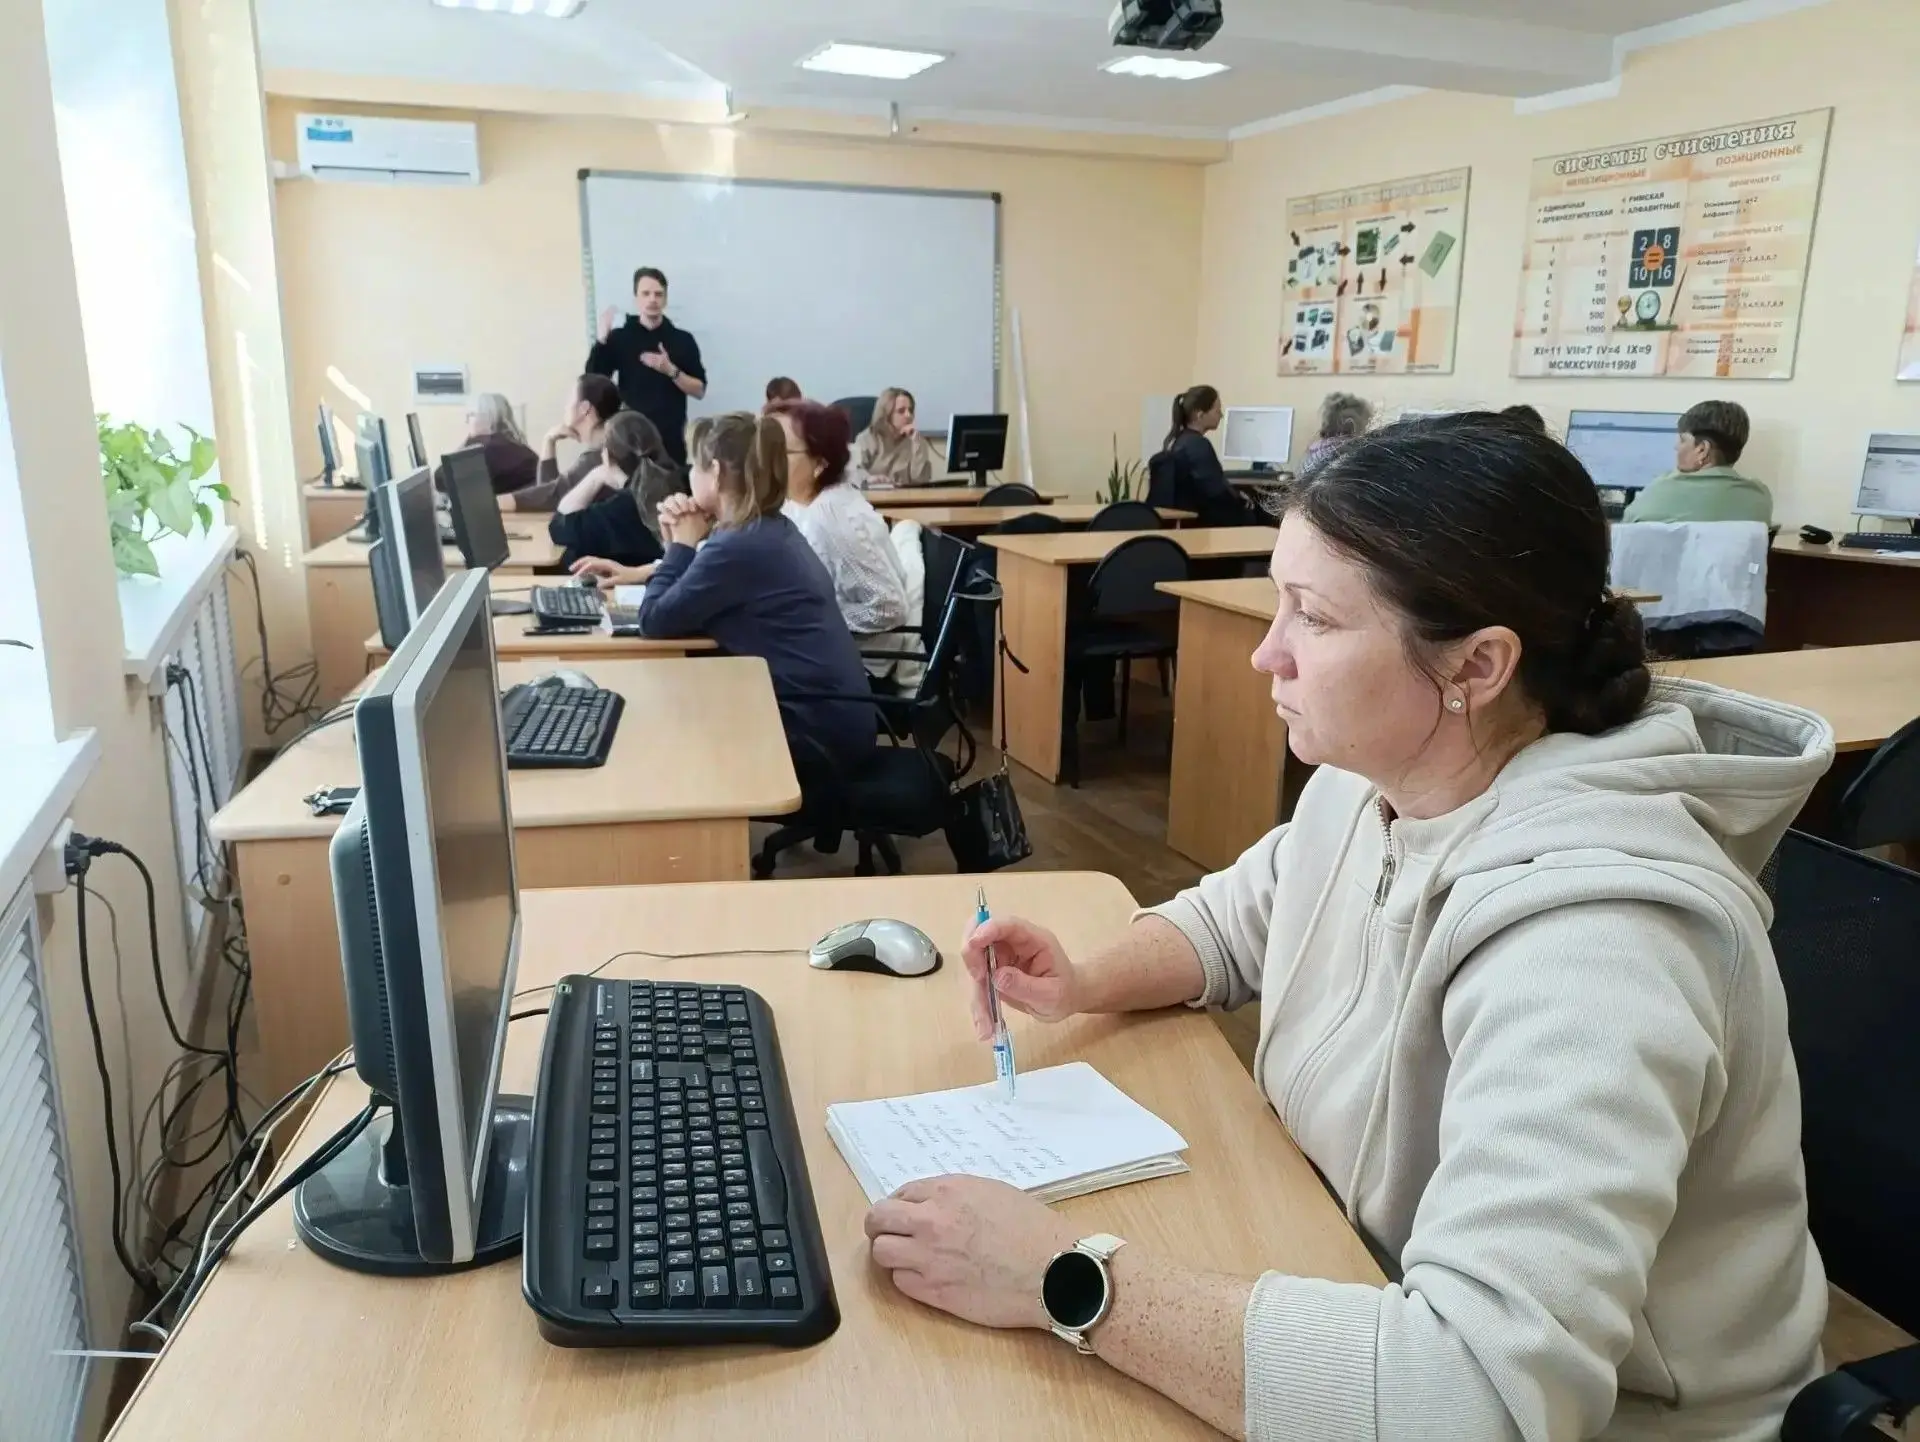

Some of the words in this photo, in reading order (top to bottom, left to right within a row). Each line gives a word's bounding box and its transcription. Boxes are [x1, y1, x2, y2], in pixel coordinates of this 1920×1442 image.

[1715, 144, 1804, 167] ПОЗИЦИОННЫЕ
[1627, 202, 1681, 215] АЛФАВИТНЫЕ
[1639, 236, 1649, 252] 2
[1663, 234, 1672, 249] 8
[1633, 266, 1648, 281] 10
[1657, 264, 1673, 280] 16
[1596, 345, 1621, 355] IV=4
[1626, 344, 1653, 355] IX=9
[1548, 359, 1638, 370] MCMXCVIII=1998
